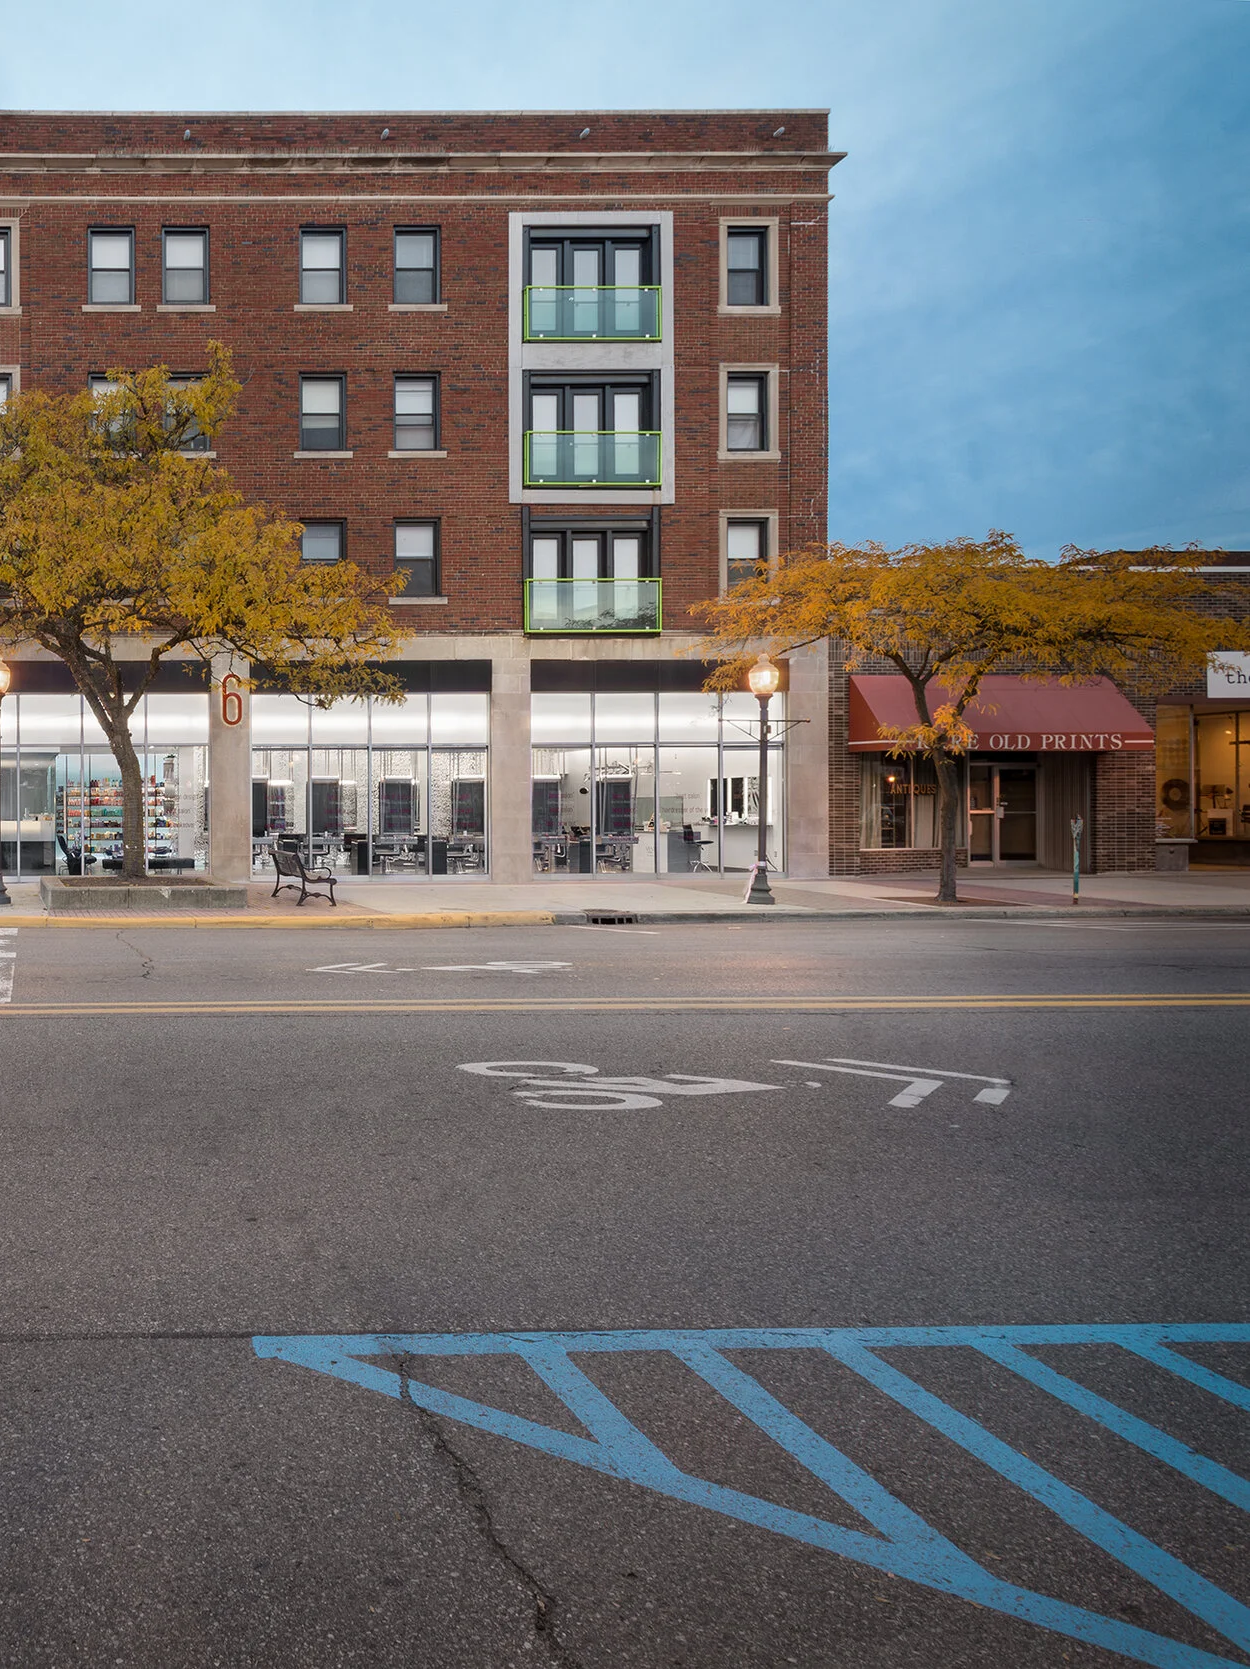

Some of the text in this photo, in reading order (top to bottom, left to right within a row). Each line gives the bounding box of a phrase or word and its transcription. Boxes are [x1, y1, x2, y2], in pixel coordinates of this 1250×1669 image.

[1225, 669, 1250, 685] th
[221, 672, 243, 727] 6
[916, 733, 1123, 751] RRE OLD PRINTS
